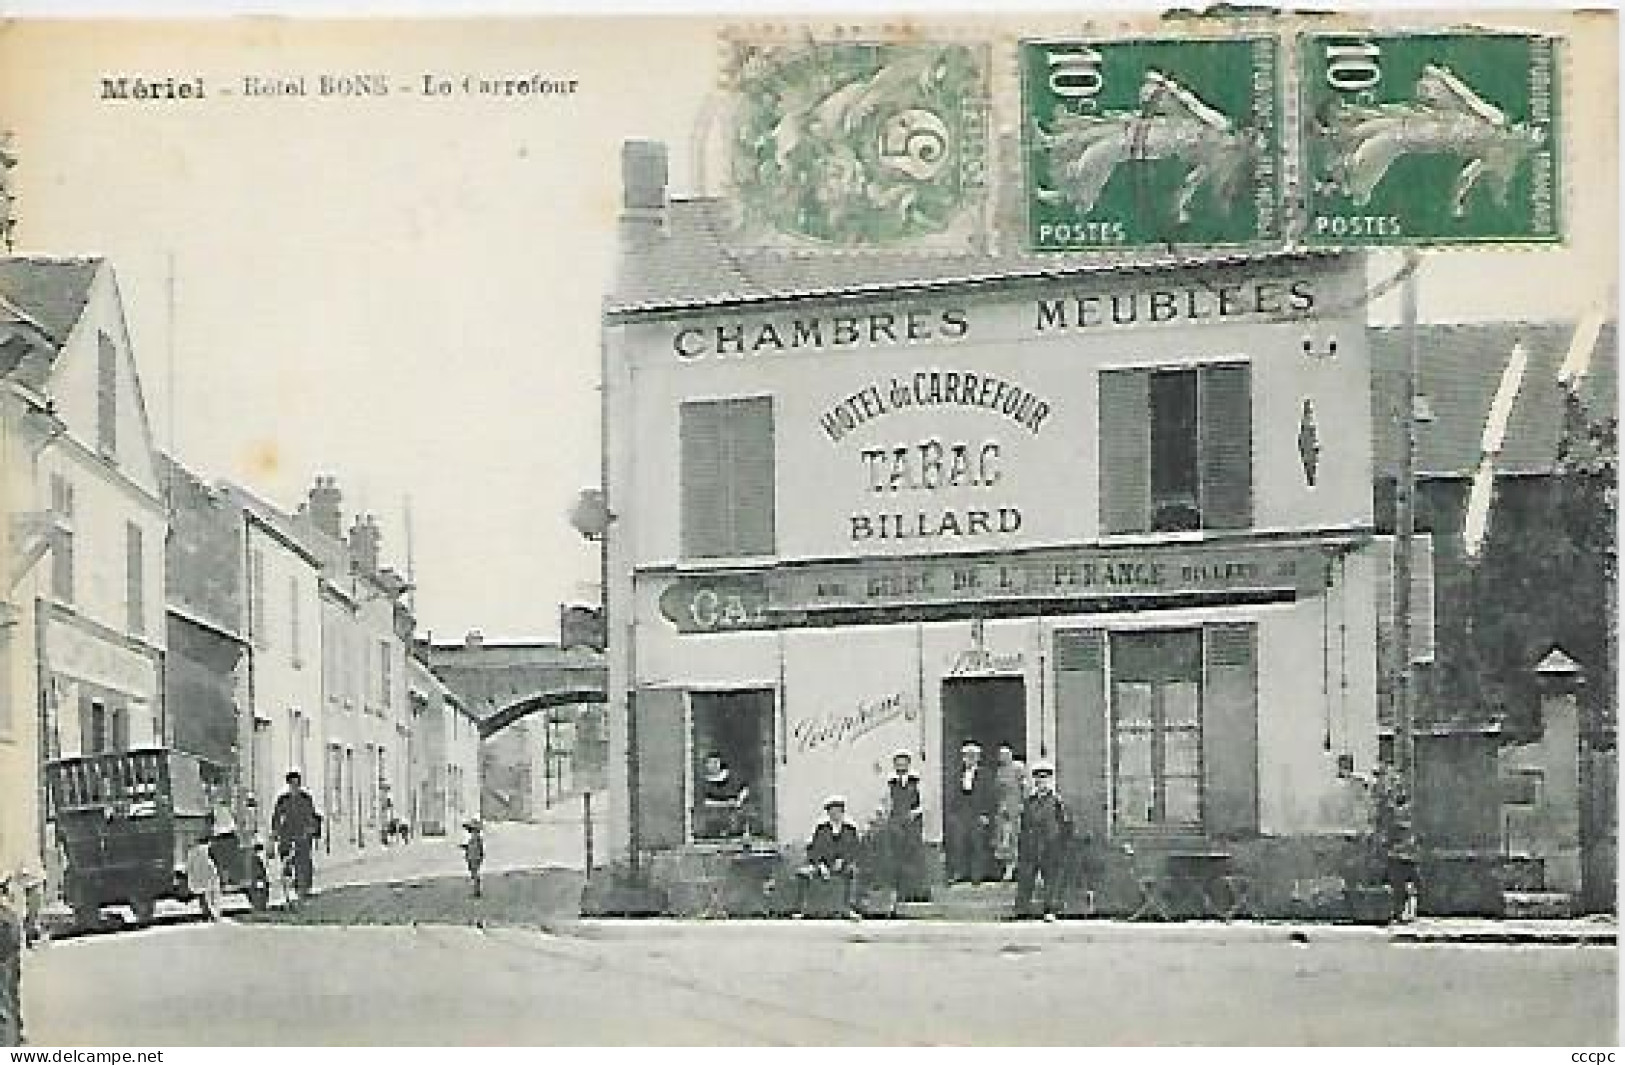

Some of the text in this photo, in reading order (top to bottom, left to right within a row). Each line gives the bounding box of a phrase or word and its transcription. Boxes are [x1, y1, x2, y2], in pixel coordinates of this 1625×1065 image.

[1039, 222, 1126, 242] POSTES
[1314, 216, 1401, 236] POSTES
[673, 308, 970, 358] CHAMBRES
[820, 387, 887, 441] HOTEL
[913, 372, 1051, 434] CARREFOUR
[860, 438, 1002, 492] TABAC
[850, 507, 1022, 541] BILLARD
